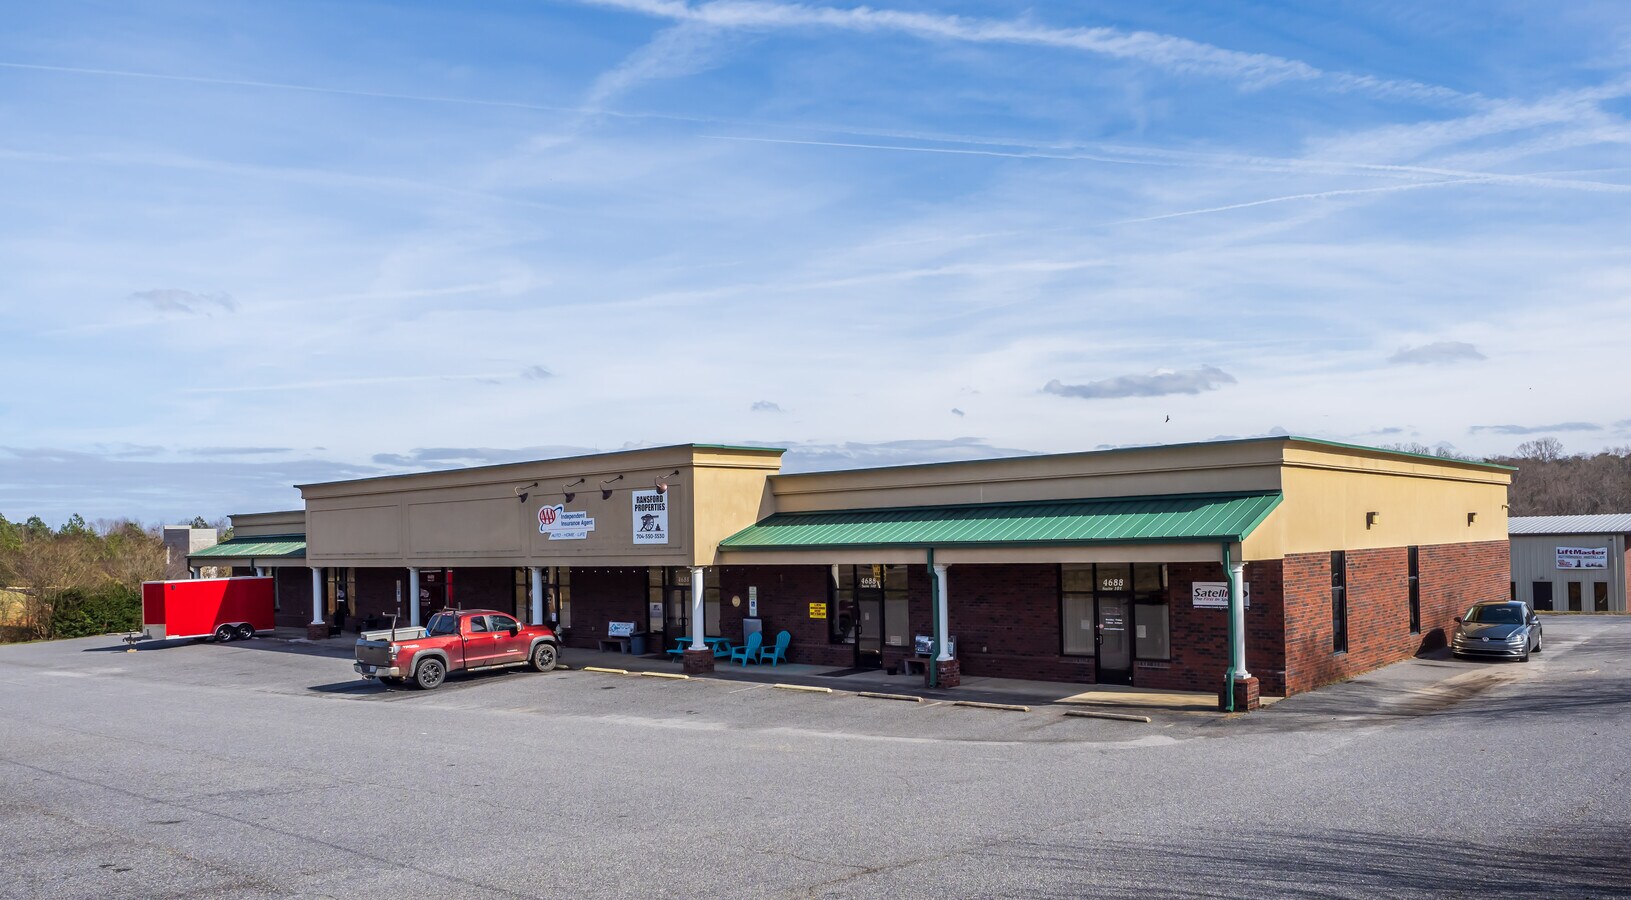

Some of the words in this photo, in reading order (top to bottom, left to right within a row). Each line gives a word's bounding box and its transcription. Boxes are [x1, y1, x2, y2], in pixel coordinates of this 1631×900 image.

[636, 495, 664, 504] RANSFORD
[634, 503, 666, 512] PROPERTIES
[540, 508, 556, 525] AAA
[561, 513, 585, 521] Independent
[581, 519, 593, 527] Agent
[1103, 578, 1124, 587] 4688
